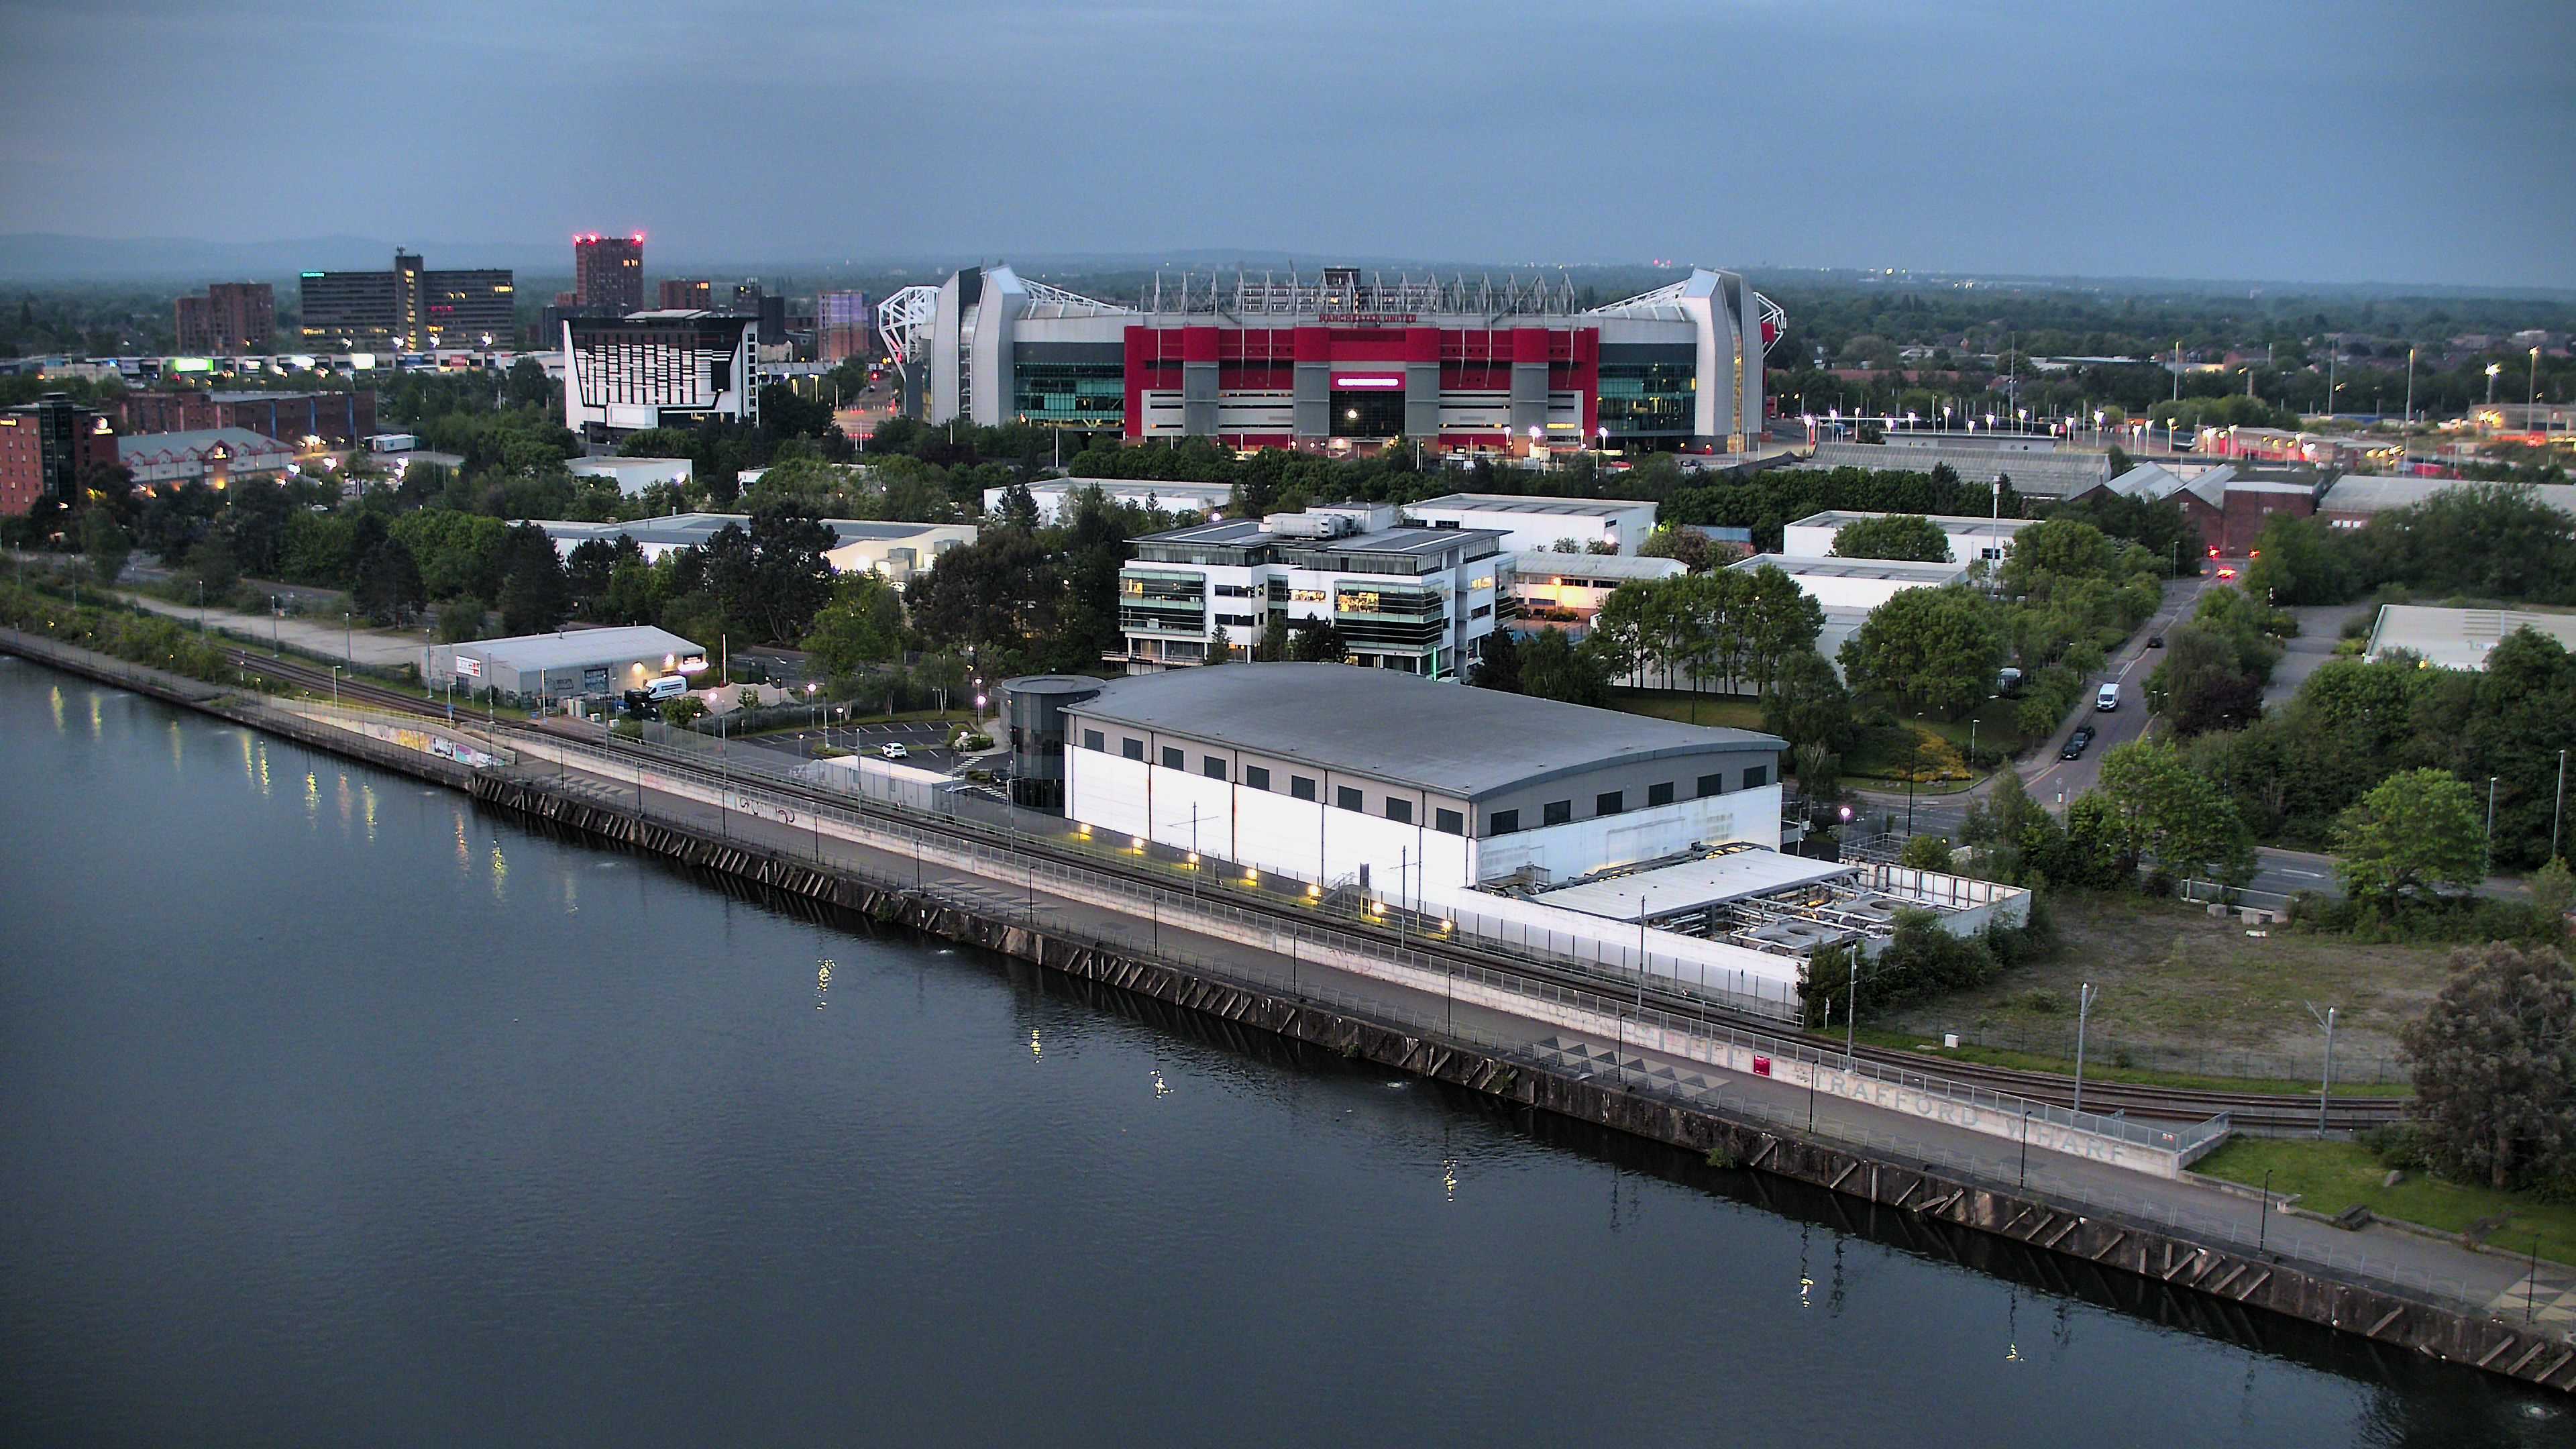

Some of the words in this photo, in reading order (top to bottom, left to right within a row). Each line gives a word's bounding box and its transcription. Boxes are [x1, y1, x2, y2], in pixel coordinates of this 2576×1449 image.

[1319, 313, 1381, 323] MANCHESTER
[1384, 313, 1417, 323] UNITED
[1811, 1071, 1978, 1126] TRAFFORD
[2005, 1118, 2125, 1162] WHARF
